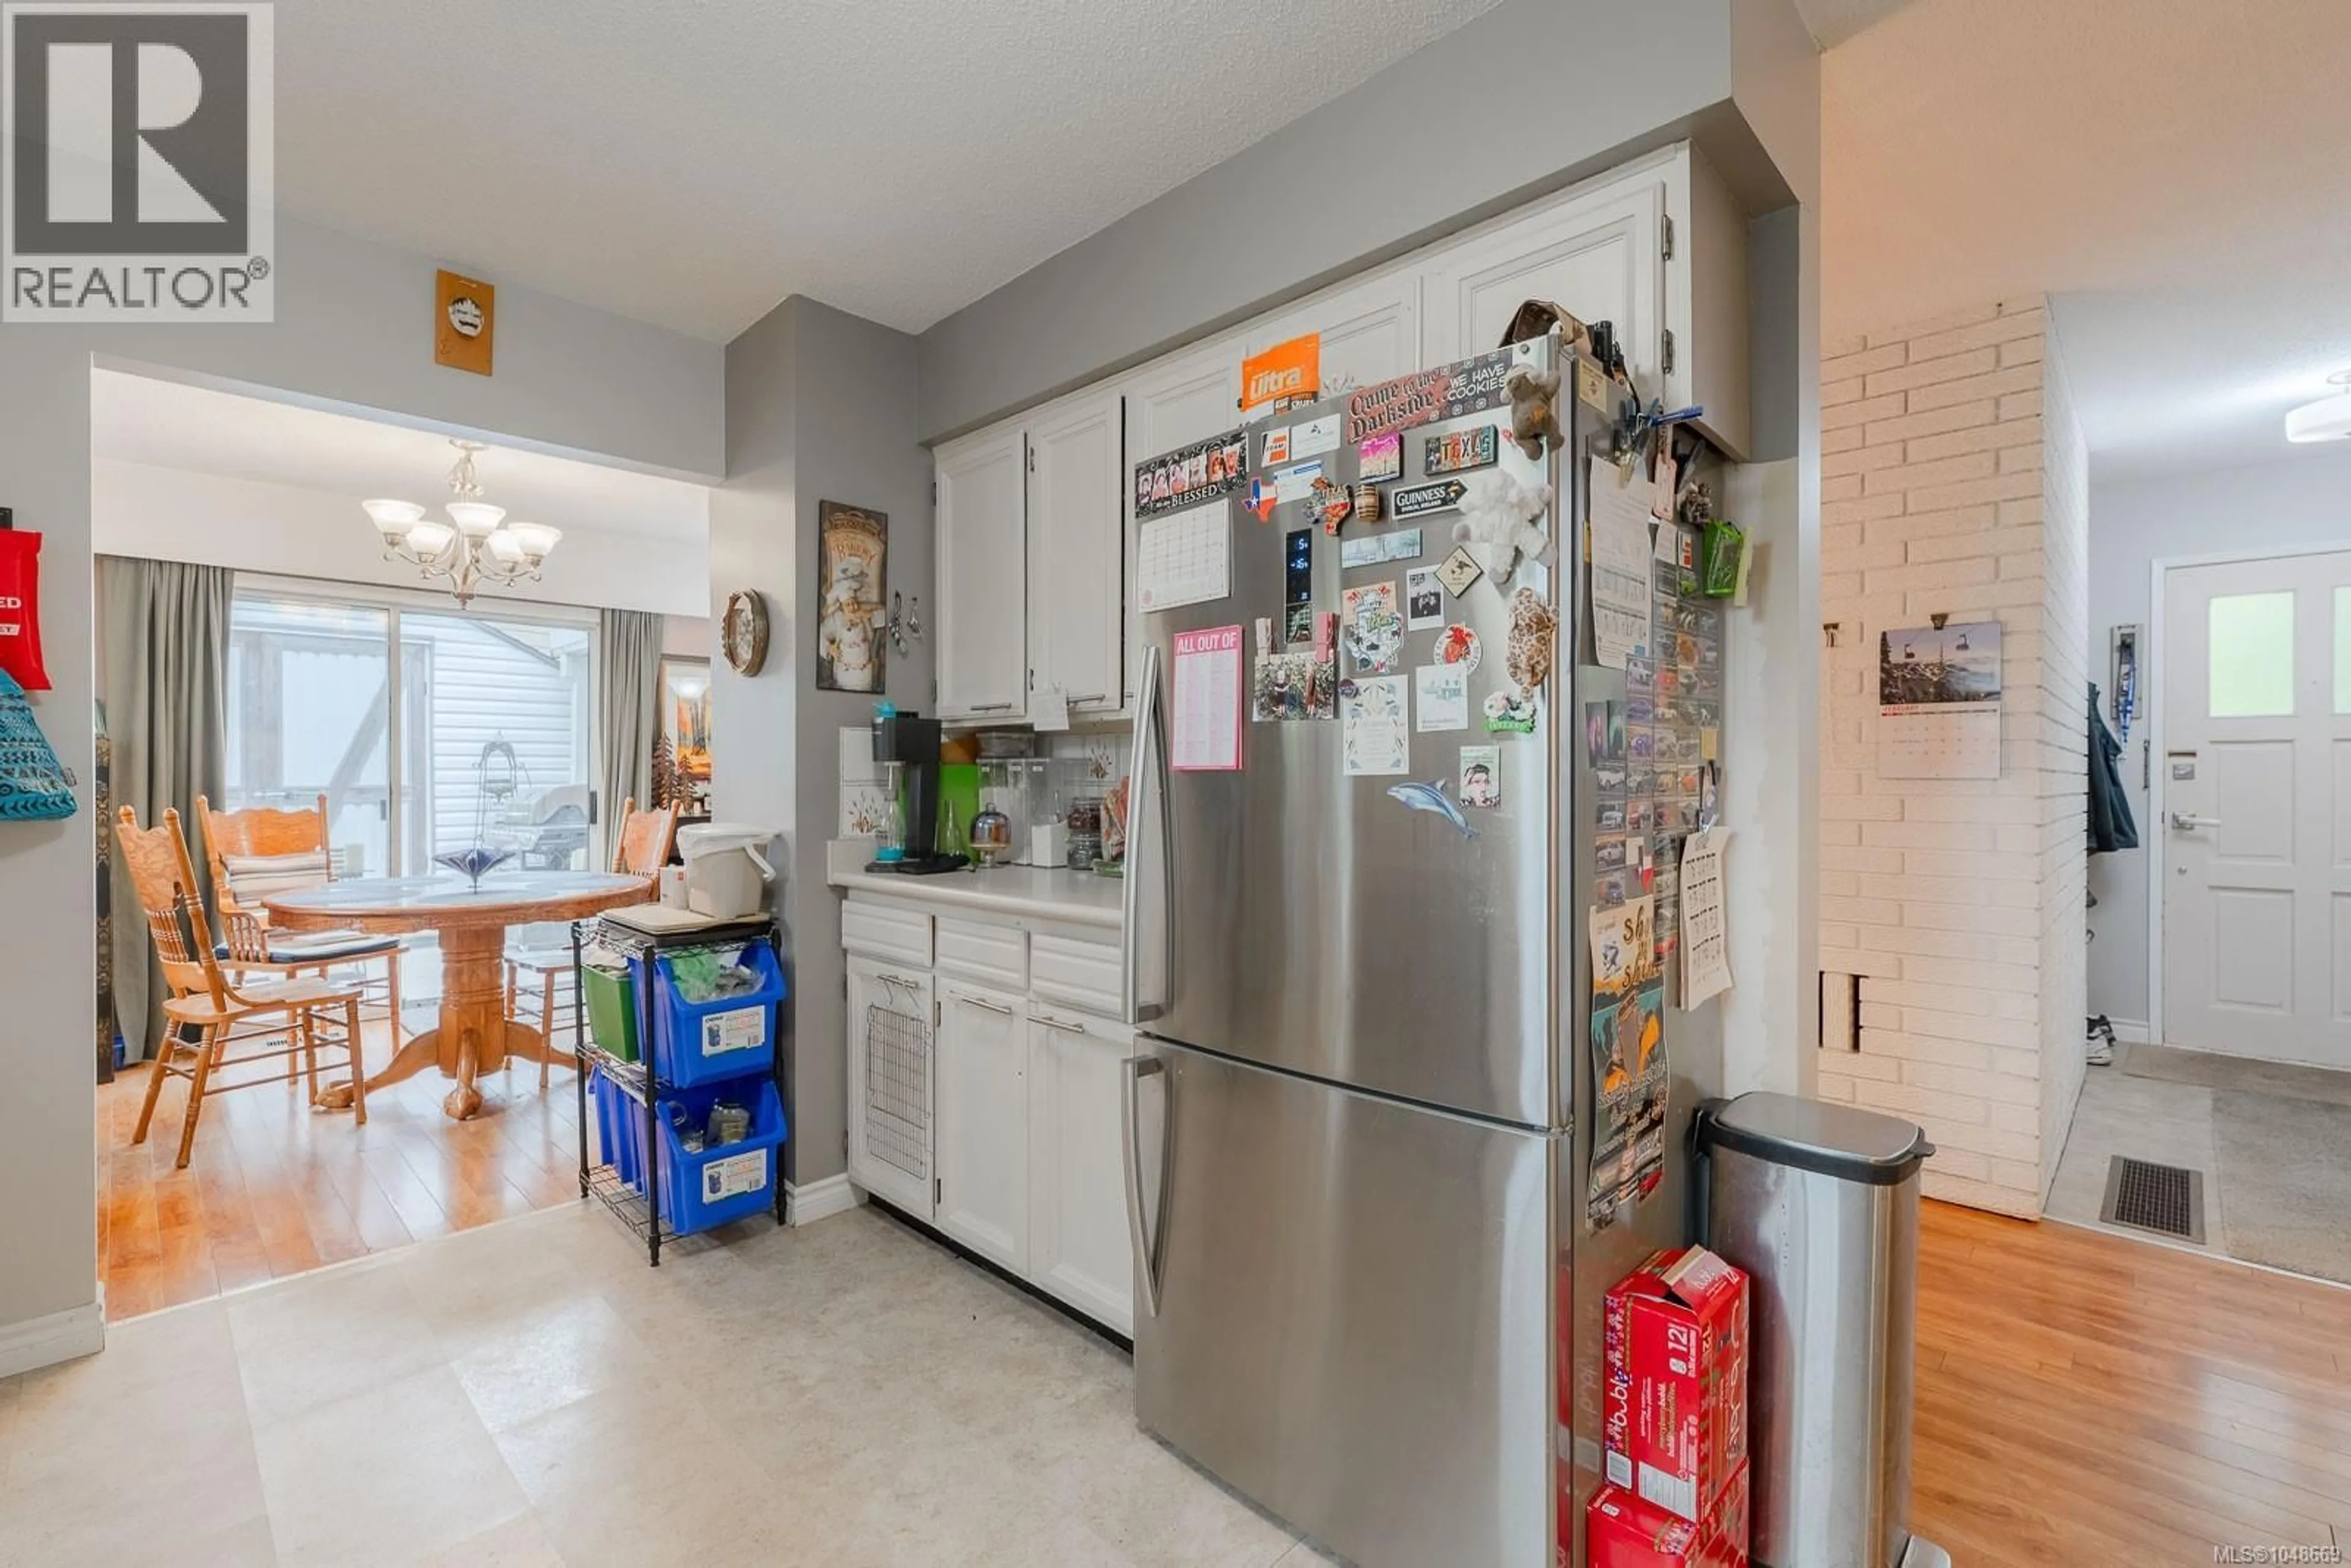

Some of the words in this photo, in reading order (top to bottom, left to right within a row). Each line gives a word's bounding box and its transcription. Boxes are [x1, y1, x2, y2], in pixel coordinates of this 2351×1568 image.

[1449, 374, 1467, 388] WE
[1472, 364, 1505, 380] HAVE
[1447, 376, 1506, 401] COOKIES
[1171, 484, 1218, 507] BLESSED
[1397, 486, 1445, 507] GUINNESS
[1177, 637, 1196, 655] ALL
[1197, 634, 1220, 651] OUT
[1221, 632, 1237, 650] OF
